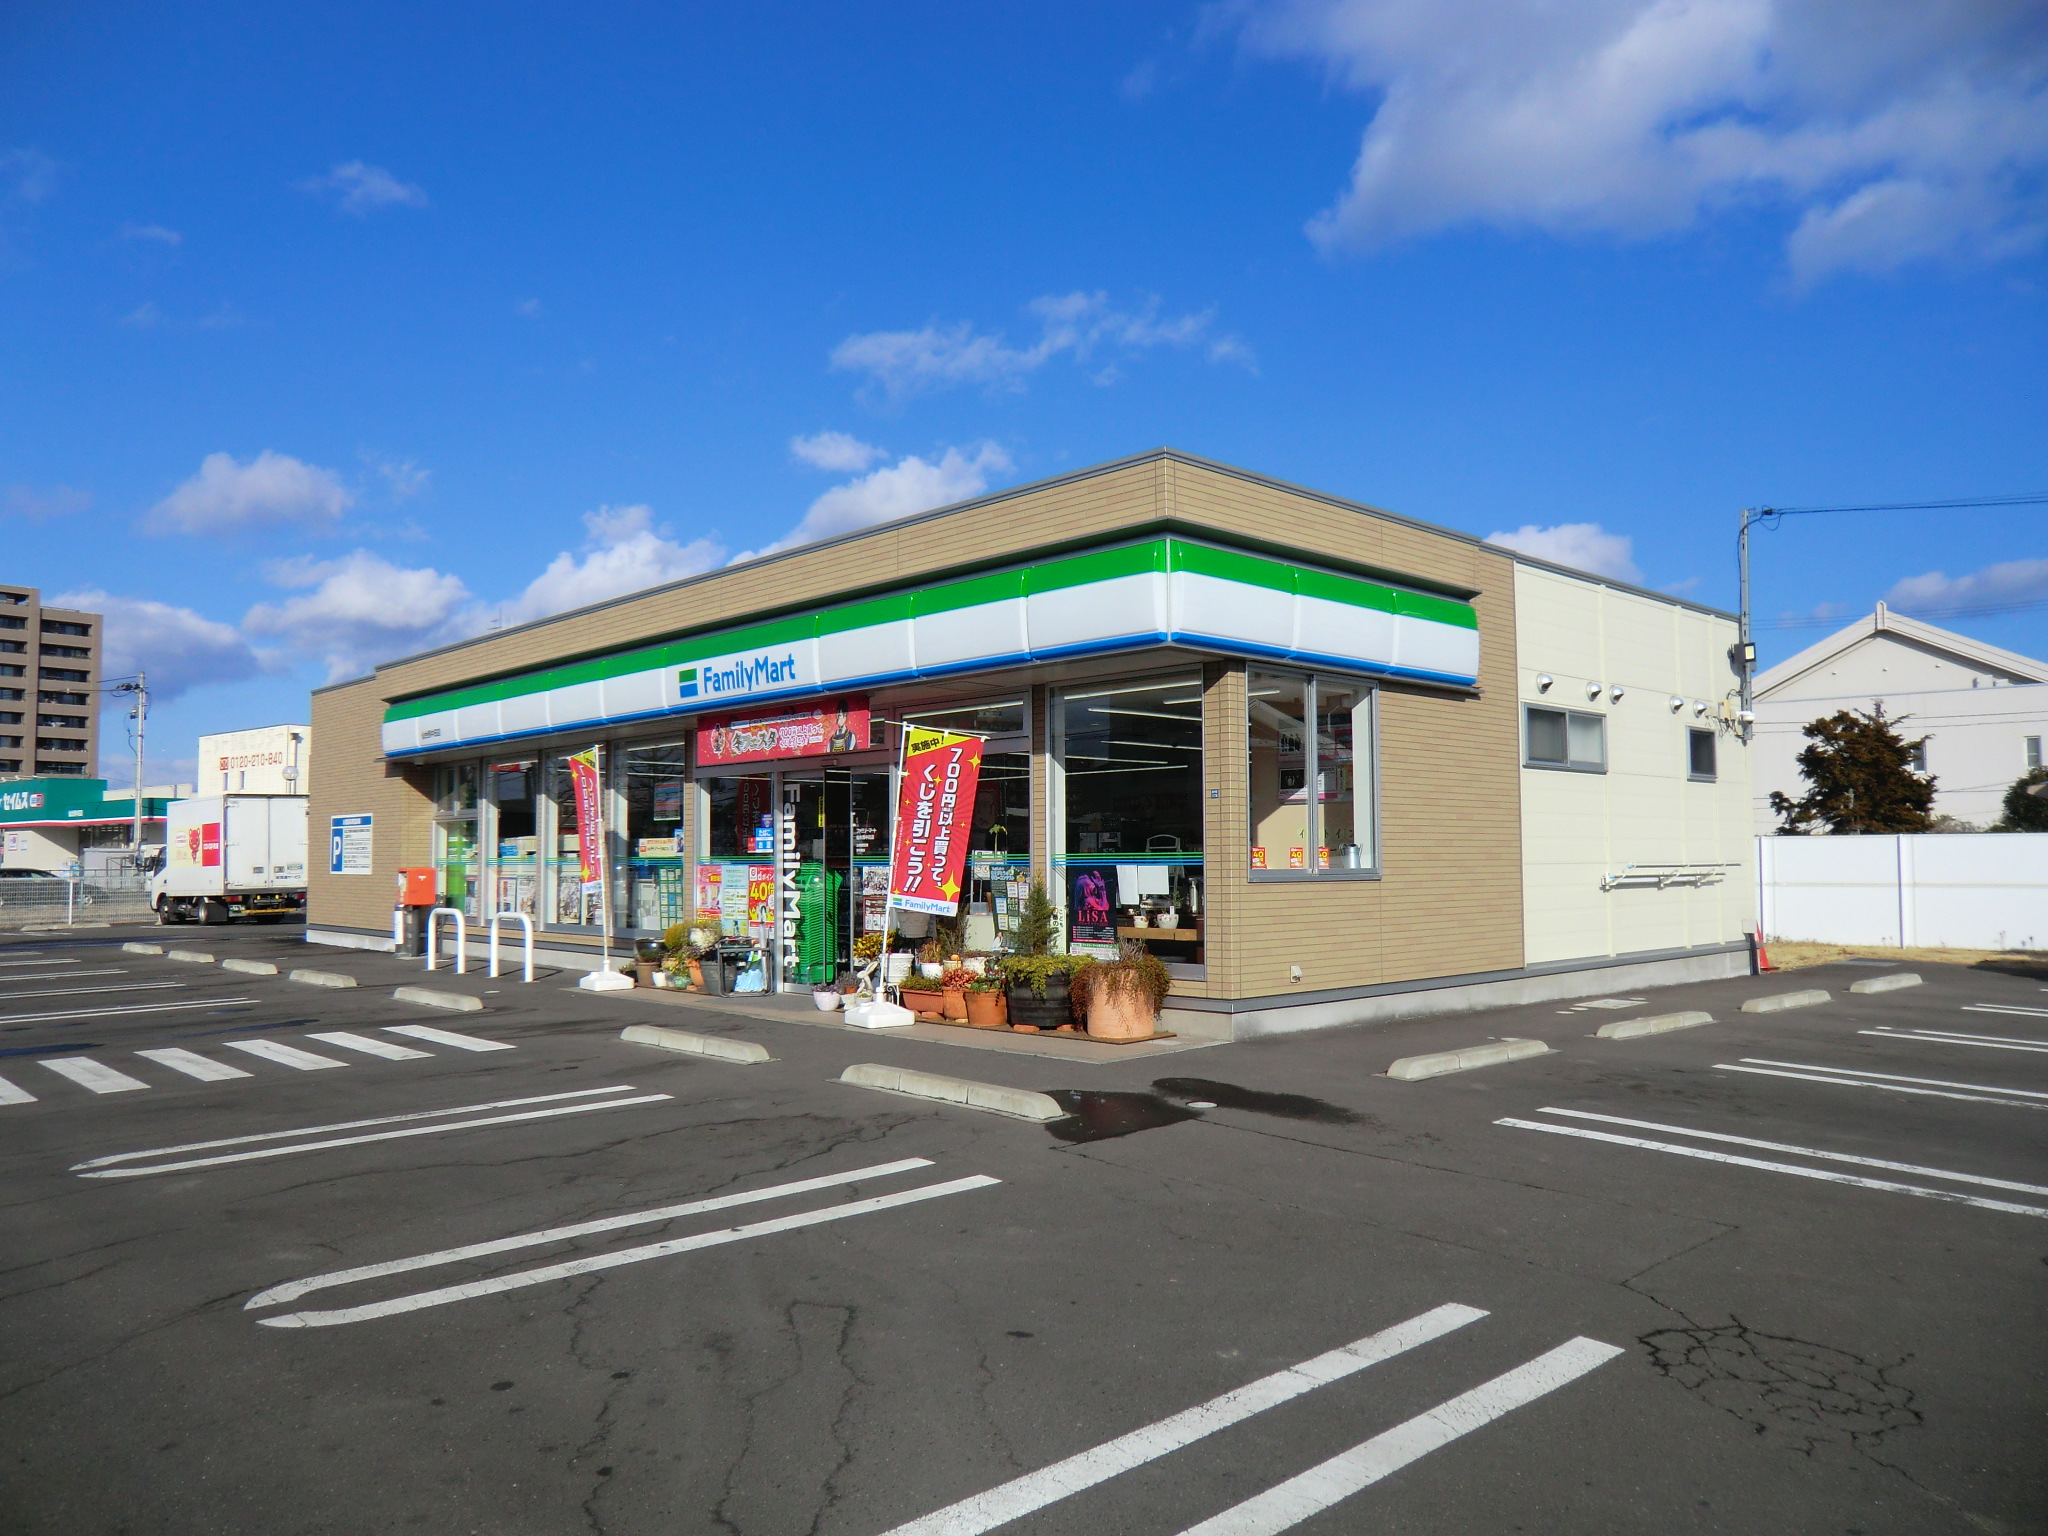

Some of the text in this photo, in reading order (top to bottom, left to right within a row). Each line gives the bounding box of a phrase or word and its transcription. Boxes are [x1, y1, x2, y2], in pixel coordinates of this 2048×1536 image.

[703, 653, 796, 694] FamilyMart
[230, 752, 283, 769] 0120-210-840
[3, 792, 28, 810] セイムス
[333, 836, 342, 864] P
[783, 783, 801, 968] FamilyMart
[904, 898, 951, 913] FamilyMart
[1078, 910, 1108, 922] LiSA
